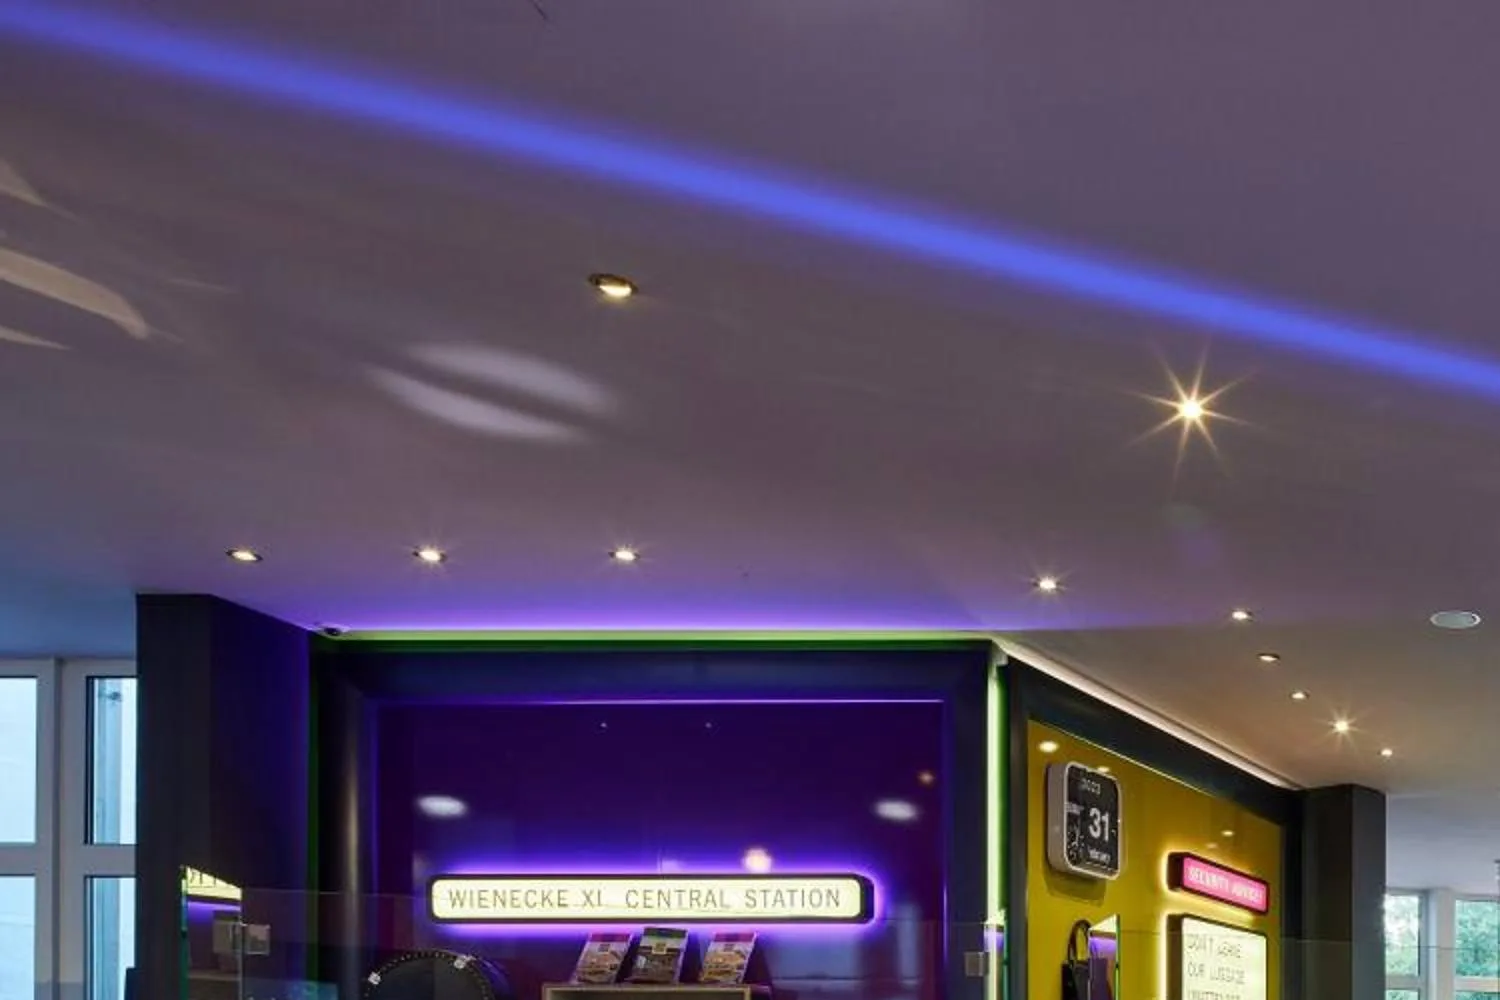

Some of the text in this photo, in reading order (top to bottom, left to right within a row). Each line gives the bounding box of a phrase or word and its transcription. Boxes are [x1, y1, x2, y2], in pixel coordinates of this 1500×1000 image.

[1088, 807, 1110, 842] 31
[448, 888, 569, 909] WIENECKE
[625, 888, 731, 909] CENTRAL
[744, 888, 841, 909] STATION
